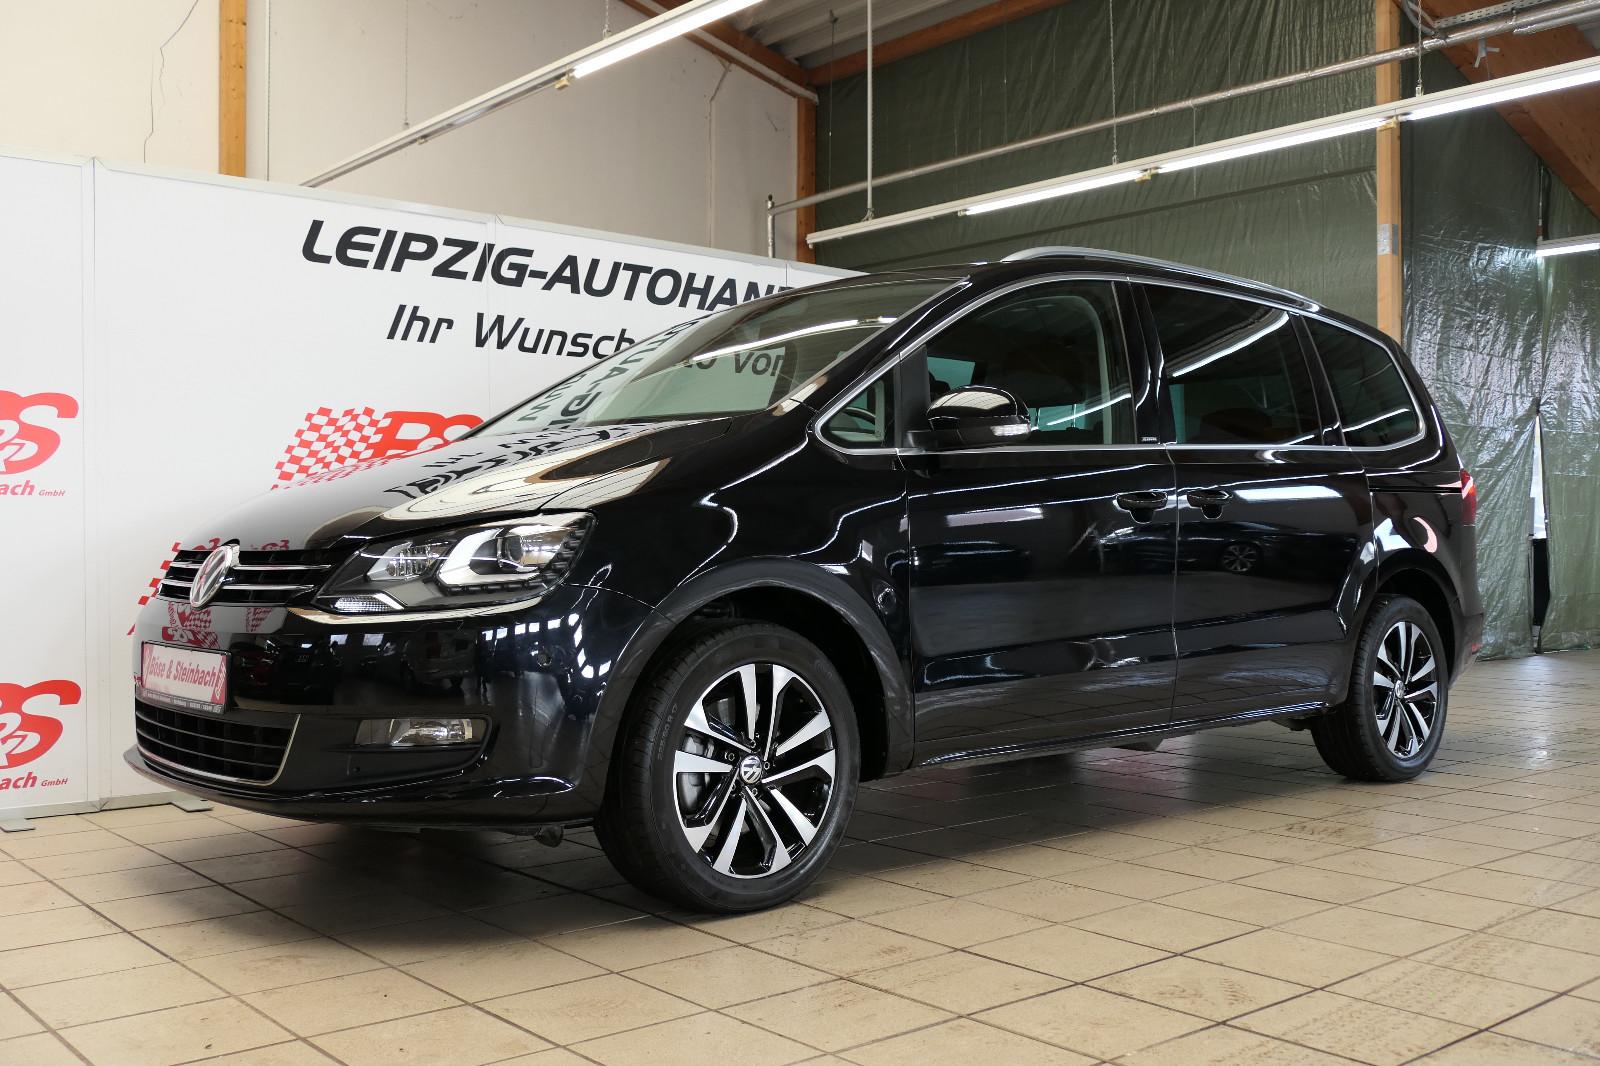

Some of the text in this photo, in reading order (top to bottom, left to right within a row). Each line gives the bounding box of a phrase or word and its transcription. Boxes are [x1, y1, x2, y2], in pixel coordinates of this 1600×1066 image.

[302, 219, 795, 312] LEIPZIG-AUTOHAN
[386, 304, 454, 344] Ihr
[38, 489, 67, 497] GmbH
[166, 659, 174, 680] &
[174, 660, 217, 688] Steinbach
[41, 777, 69, 787] GmbH
